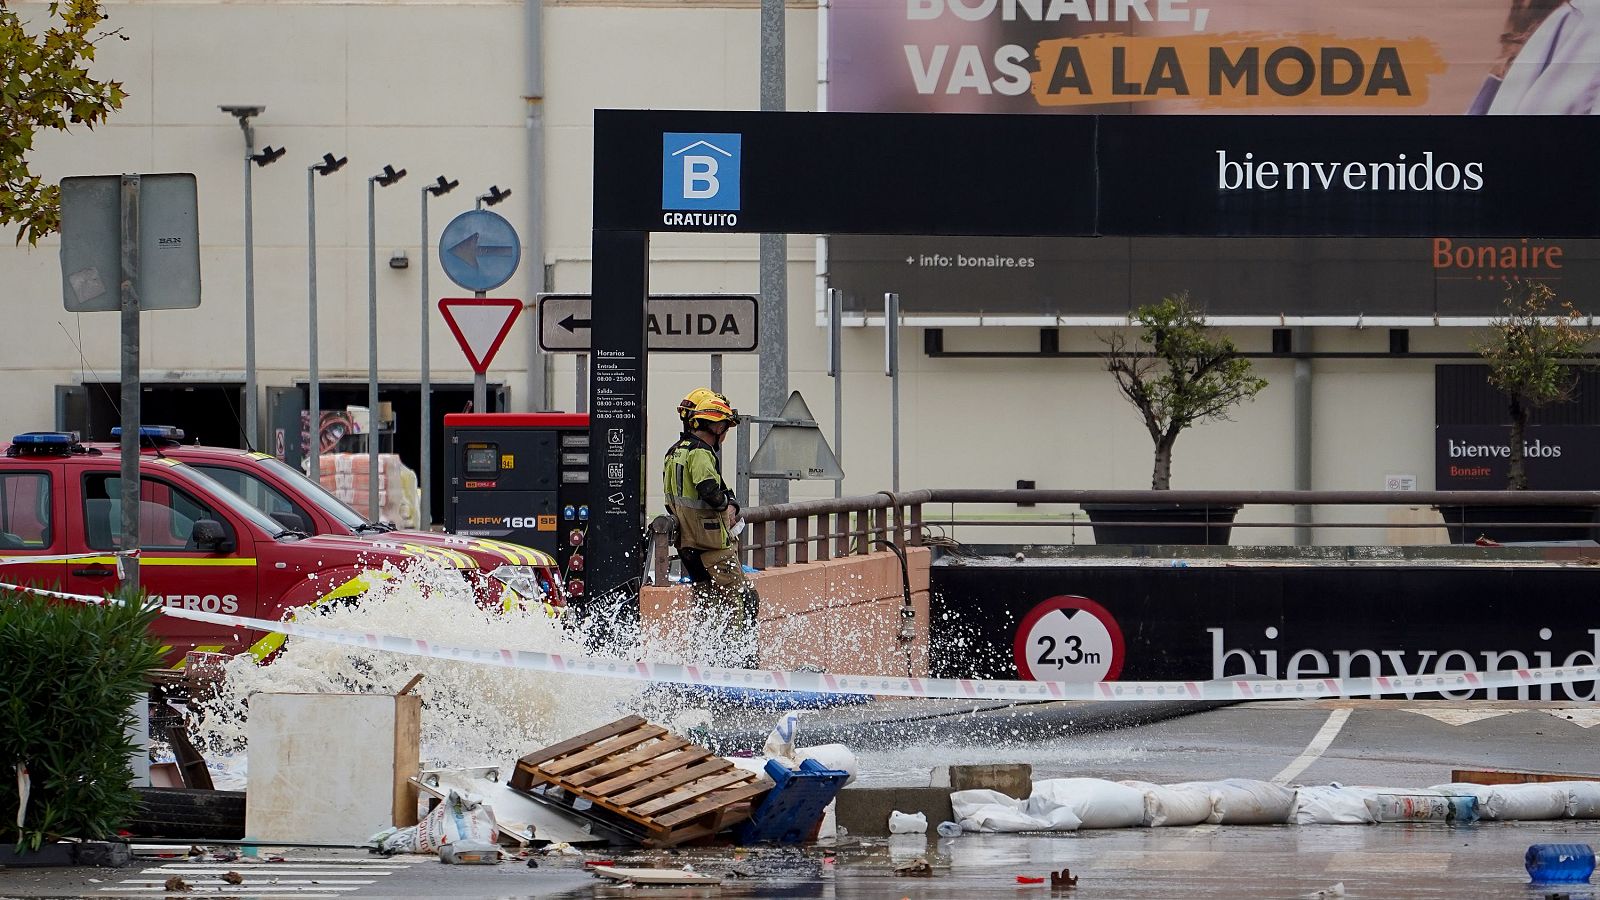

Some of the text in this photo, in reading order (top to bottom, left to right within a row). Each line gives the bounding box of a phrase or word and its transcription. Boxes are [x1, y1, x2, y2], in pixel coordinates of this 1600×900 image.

[903, 44, 1412, 97] VAS A LA MODA
[683, 155, 720, 199] B
[1216, 150, 1484, 191] bienvenidos
[663, 212, 737, 226] GRATUITO
[919, 254, 953, 267] info:
[957, 254, 1035, 268] bonaire.es
[1433, 238, 1563, 269] Bonaire
[648, 313, 740, 335] ALIDA
[597, 349, 625, 357] Horarios
[1448, 438, 1562, 458] bienveidos
[1450, 466, 1492, 477] Bonaire
[502, 517, 536, 528] 160
[147, 594, 239, 614] EROS
[1037, 635, 1101, 671] 2,3m
